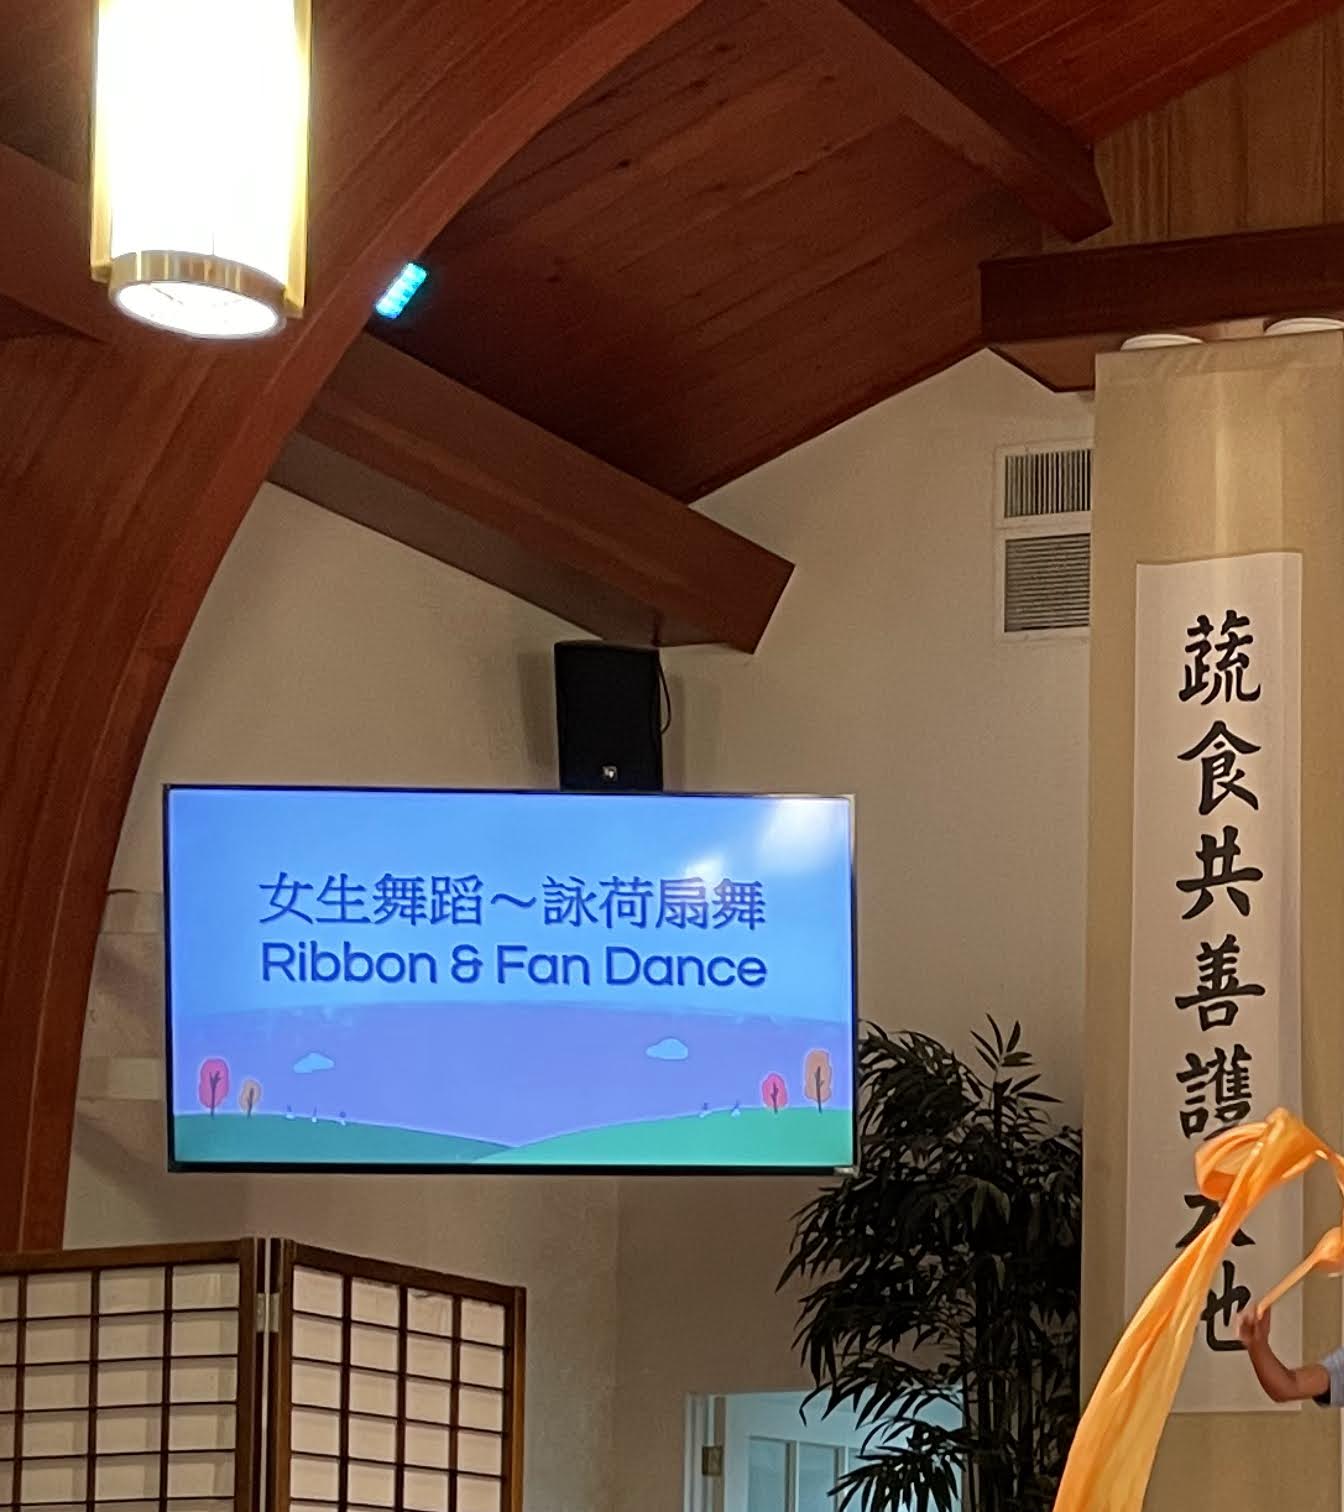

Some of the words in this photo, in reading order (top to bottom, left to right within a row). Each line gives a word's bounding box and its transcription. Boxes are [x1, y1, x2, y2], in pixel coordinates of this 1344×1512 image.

[261, 940, 437, 985] Ribbon
[451, 943, 483, 985] &
[497, 944, 590, 986] Fan
[605, 946, 768, 988] Dance
